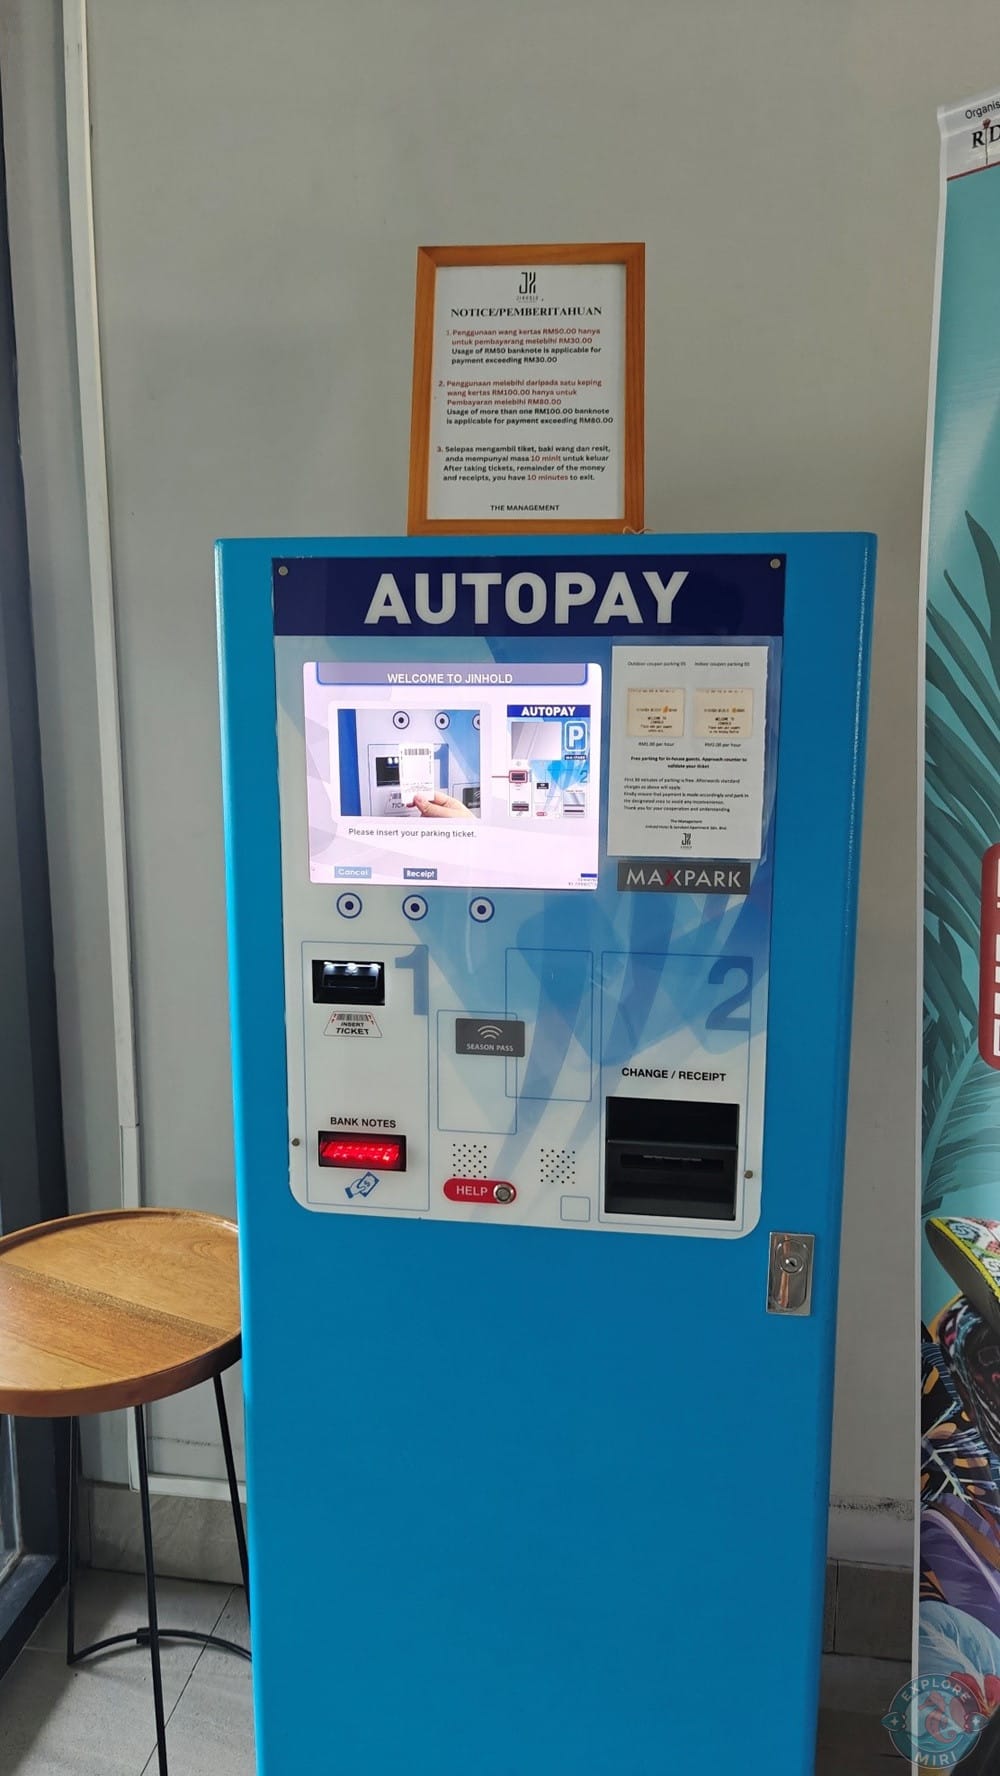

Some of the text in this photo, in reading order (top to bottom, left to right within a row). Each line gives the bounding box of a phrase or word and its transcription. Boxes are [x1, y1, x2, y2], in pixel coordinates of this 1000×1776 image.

[451, 306, 602, 318] NOTICE/PEMBERITAHUAN
[452, 329, 496, 337] Penggunaan
[551, 346, 589, 356] applicable
[452, 358, 483, 366] payment
[485, 356, 522, 364] exceeding
[447, 380, 491, 388] Penggunaan
[526, 379, 558, 388] daripada
[578, 379, 602, 388] keping
[532, 389, 554, 397] hanya
[448, 399, 492, 407] Pembayaran
[446, 408, 469, 416] Usage
[454, 418, 492, 426] applicable
[506, 418, 538, 426] payment
[540, 418, 578, 426] exceeding
[476, 446, 516, 454] mengambil
[464, 464, 486, 472] taking
[488, 464, 515, 472] tickets,
[364, 571, 690, 625] AUTOPAY
[387, 673, 513, 684] WELCOME TO JINHOLD
[522, 706, 576, 716] AUTOPAY
[348, 828, 477, 838] Please insert your parking ticket.
[338, 868, 436, 879] Cancel Receipt
[626, 868, 742, 888] MAXPARK
[395, 945, 429, 1015] 1
[705, 956, 753, 1031] 2
[466, 1042, 494, 1051] SEASON
[622, 1067, 726, 1082] CHANGE / RECEIPT
[330, 1116, 396, 1128] BANK NOTES
[456, 1184, 488, 1196] HELP
